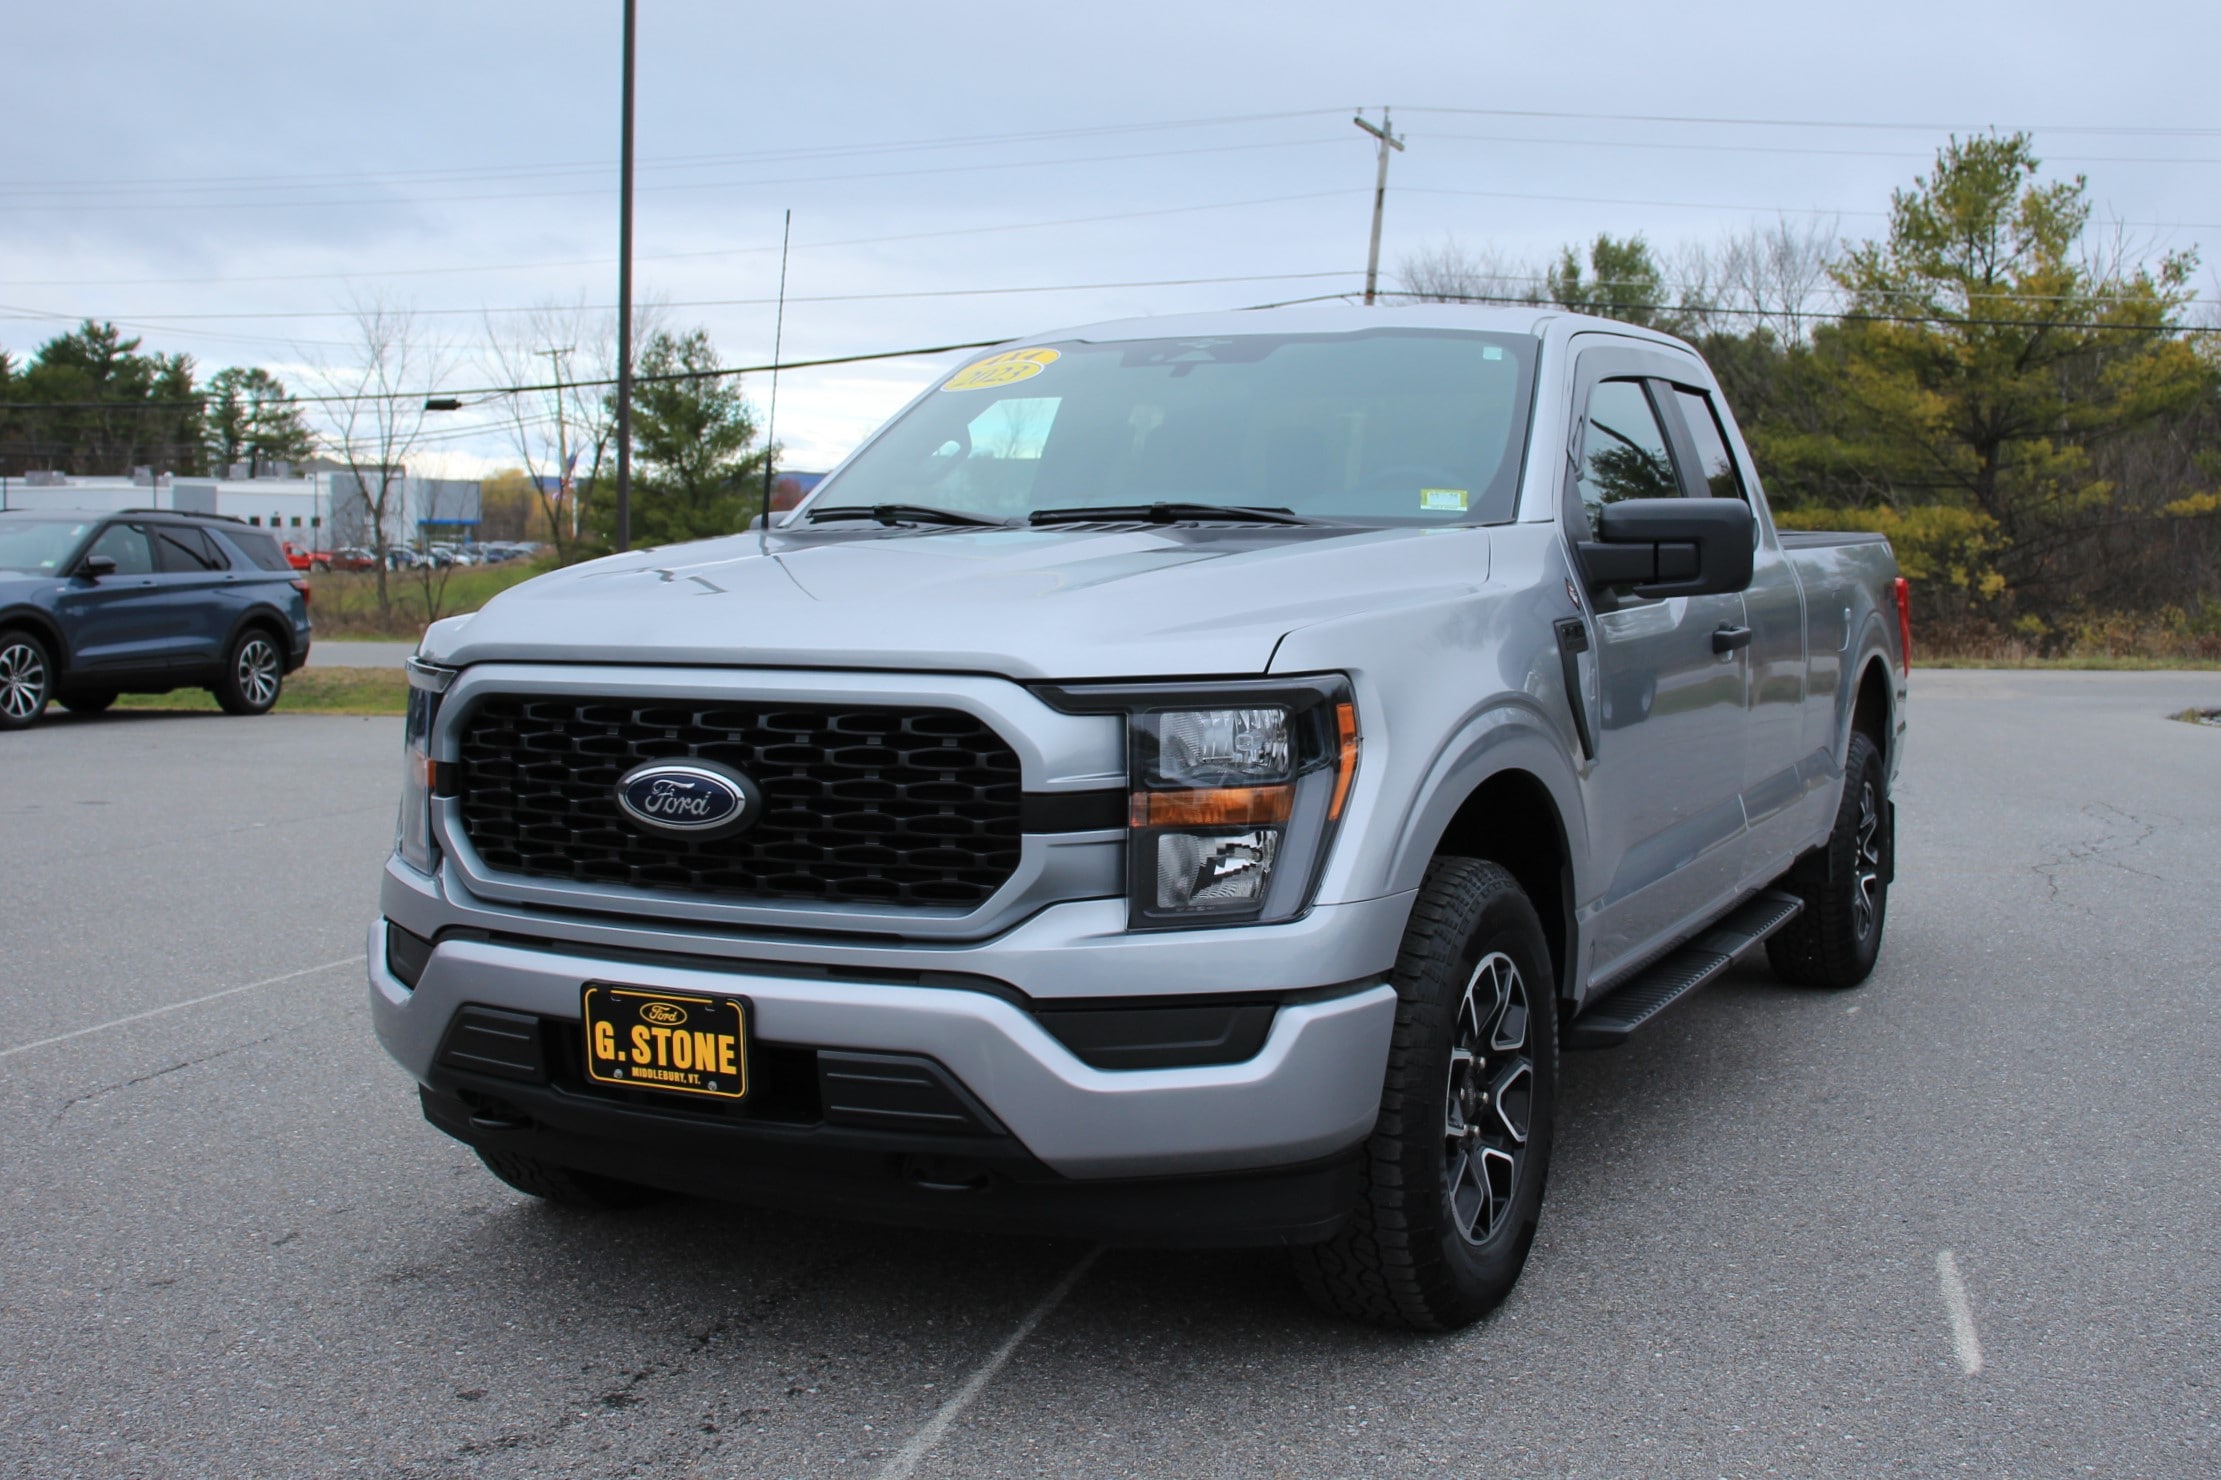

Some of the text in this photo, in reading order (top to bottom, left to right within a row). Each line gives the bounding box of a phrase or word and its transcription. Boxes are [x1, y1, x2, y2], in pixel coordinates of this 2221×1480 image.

[953, 364, 1031, 387] 2023
[644, 779, 713, 816] Ford
[649, 1004, 678, 1022] Ford
[595, 1020, 737, 1075] G. STONE
[687, 1073, 701, 1085] VT.
